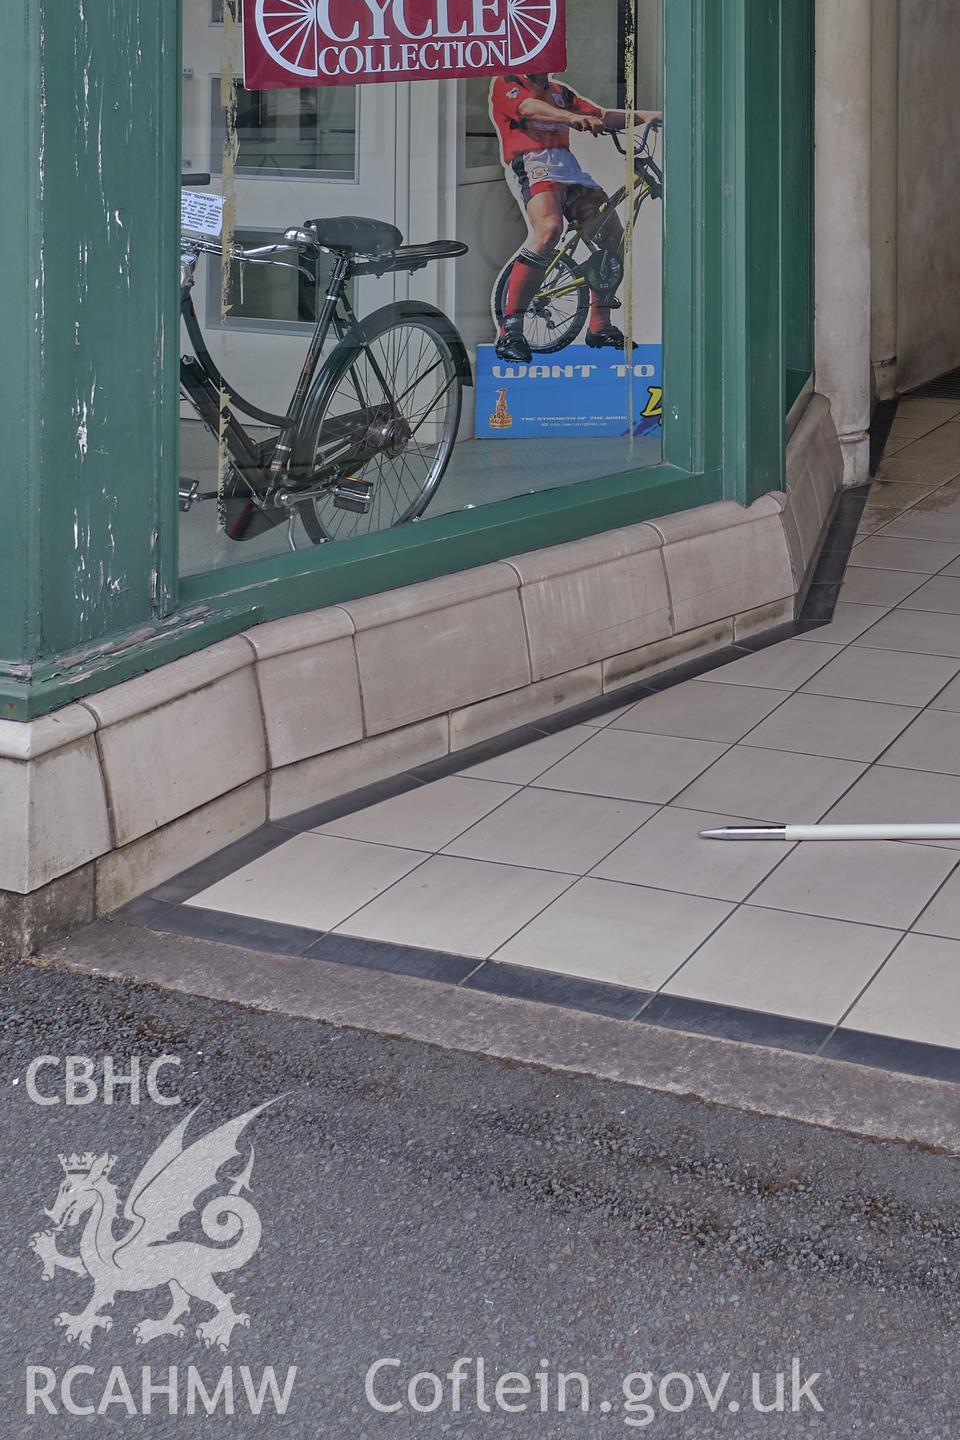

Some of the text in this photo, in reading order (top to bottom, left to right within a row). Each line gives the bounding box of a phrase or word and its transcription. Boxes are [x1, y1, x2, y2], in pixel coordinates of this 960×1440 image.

[318, 40, 507, 76] COLLECTION
[492, 363, 656, 379] WANT TO
